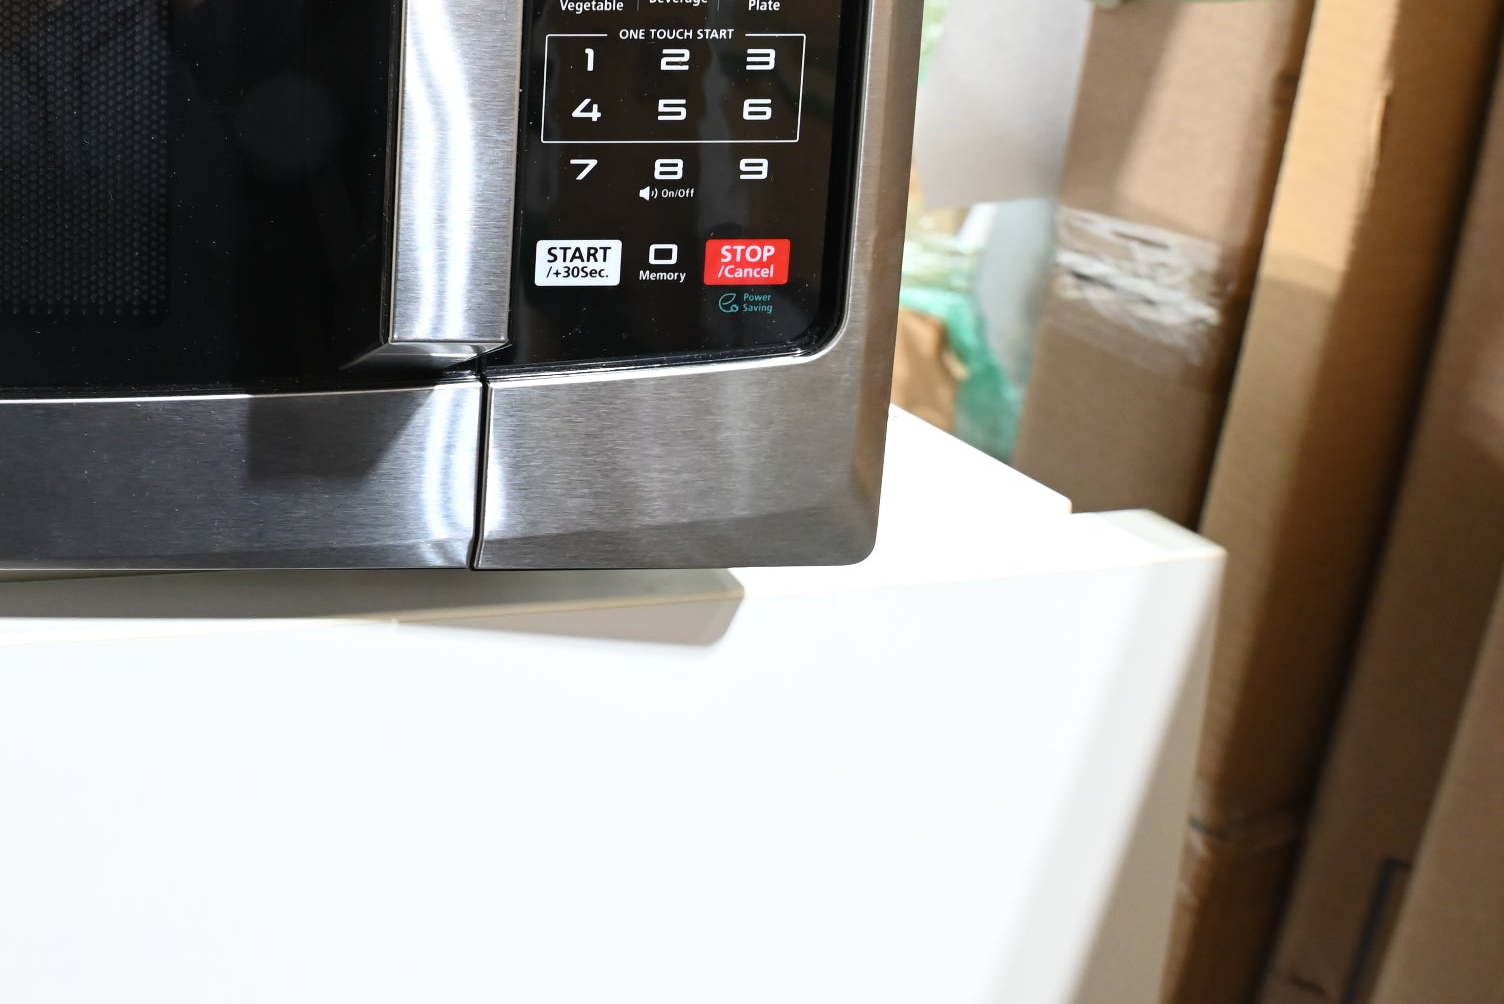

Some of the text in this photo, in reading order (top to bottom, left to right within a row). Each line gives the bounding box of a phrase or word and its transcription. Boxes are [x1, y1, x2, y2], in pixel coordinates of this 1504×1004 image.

[560, 0, 623, 14] Vegetable
[620, 29, 734, 39] ONE TOUCH START
[585, 48, 594, 71] 1
[661, 49, 689, 70] 2
[746, 49, 775, 70] 3
[572, 99, 601, 121] 4
[658, 99, 686, 120] 5
[743, 99, 771, 120] 6
[570, 159, 597, 180] 7
[654, 159, 683, 179] 8
[740, 159, 768, 179] 9
[661, 188, 695, 198] On/Off
[547, 247, 611, 263] START
[721, 245, 775, 262] STOP
[640, 270, 686, 282] Memory
[718, 265, 773, 277] /Cancel
[744, 293, 771, 301] Power
[743, 304, 772, 313] Saving
